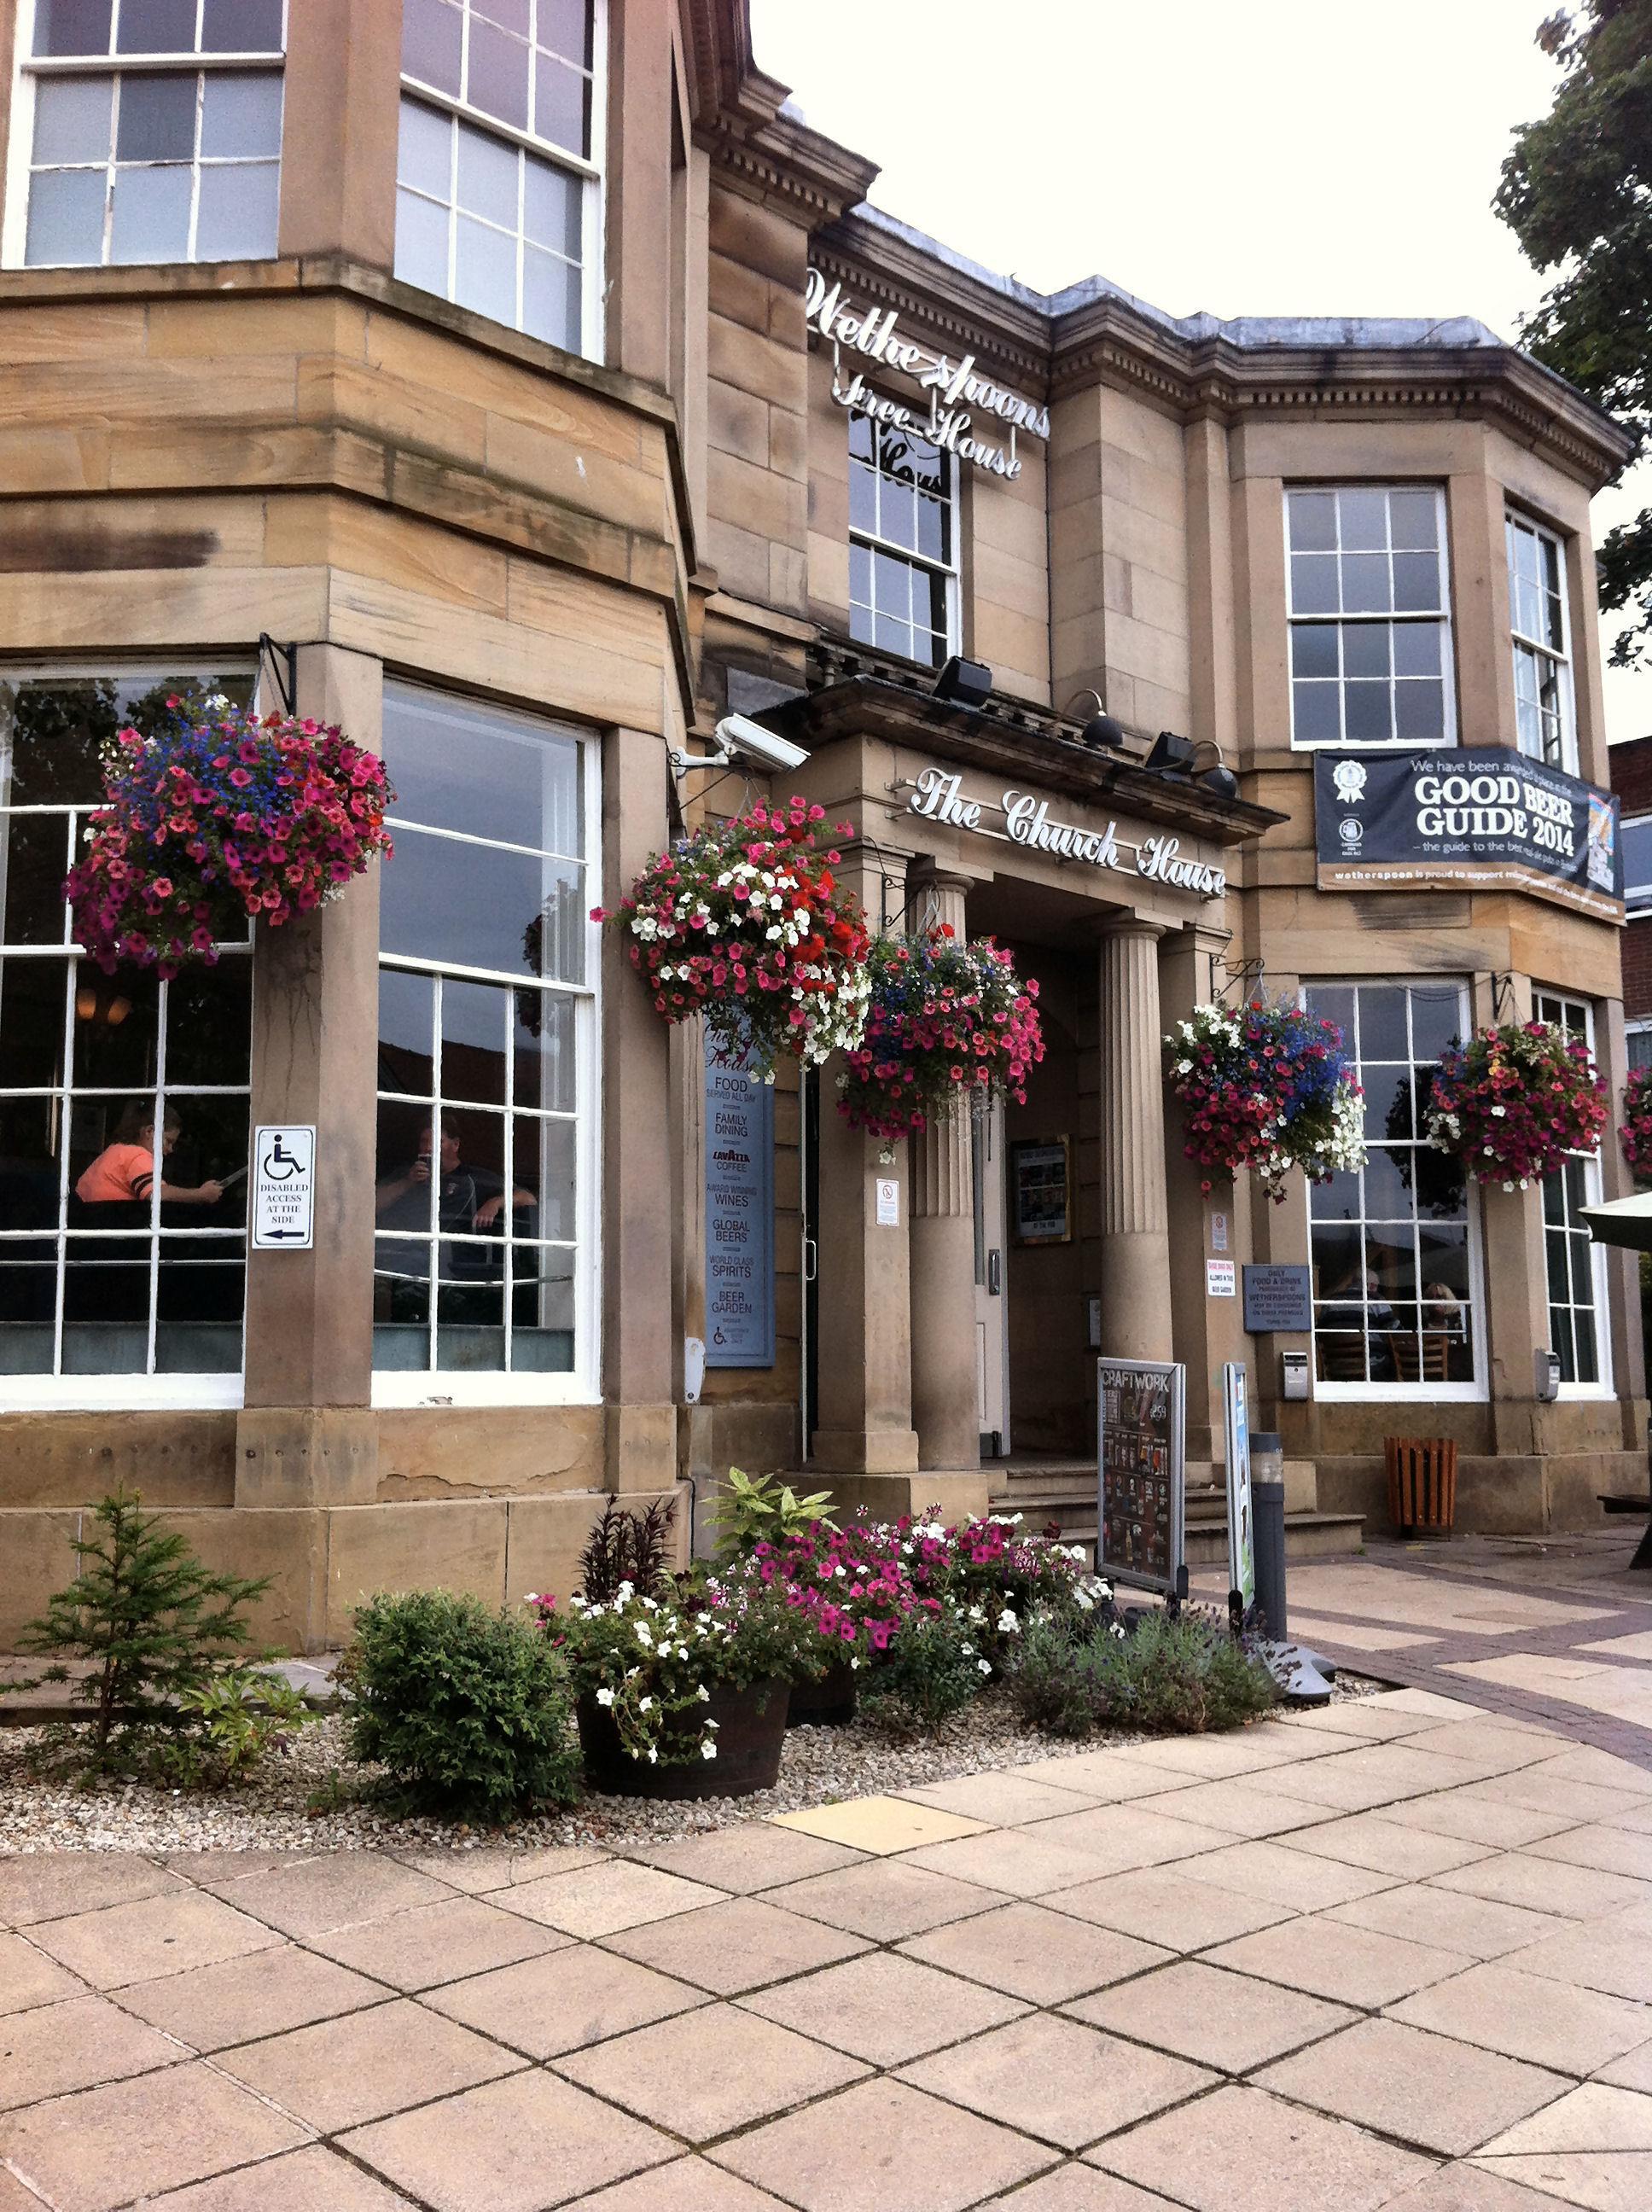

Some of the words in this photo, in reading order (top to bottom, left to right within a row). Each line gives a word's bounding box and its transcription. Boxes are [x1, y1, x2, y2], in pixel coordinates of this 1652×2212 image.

[806, 267, 1050, 440] Wetherspoons
[831, 374, 911, 428] Free
[923, 407, 1022, 481] House
[1411, 760, 1434, 772] We
[1436, 760, 1467, 772] have
[1469, 760, 1499, 772] been
[1414, 776, 1521, 805] GOOD
[1522, 783, 1574, 828] BEER
[910, 767, 981, 829] The
[1001, 790, 1120, 868] Church
[1137, 835, 1227, 894] House
[1416, 807, 1528, 839] GUIDE
[1533, 816, 1574, 858] 2014
[1422, 841, 1440, 852] the
[1442, 841, 1470, 853] guide
[1473, 841, 1485, 852] to
[1487, 841, 1505, 852] the
[1424, 870, 1453, 880] proud
[1454, 870, 1466, 879] to
[715, 1076, 747, 1092] FOOD
[731, 1091, 743, 1102] ALL
[715, 1112, 747, 1126] FAMILY
[714, 1124, 748, 1137] DINING
[713, 1150, 751, 1163] LAVAZZA
[716, 1161, 747, 1173] COFFEE
[260, 1184, 309, 1192] DISABLED
[714, 1193, 749, 1208] WINES
[282, 1205, 301, 1214] THE
[713, 1219, 750, 1232] GLOBAL
[715, 1231, 747, 1243] BEERS
[709, 1254, 732, 1266] WORLD
[735, 1256, 754, 1266] CLASS
[712, 1265, 752, 1278] SPIRITS
[718, 1290, 745, 1302] BEER
[712, 1302, 753, 1314] GARDEN
[1102, 1370, 1170, 1393] CRAFTWORK
